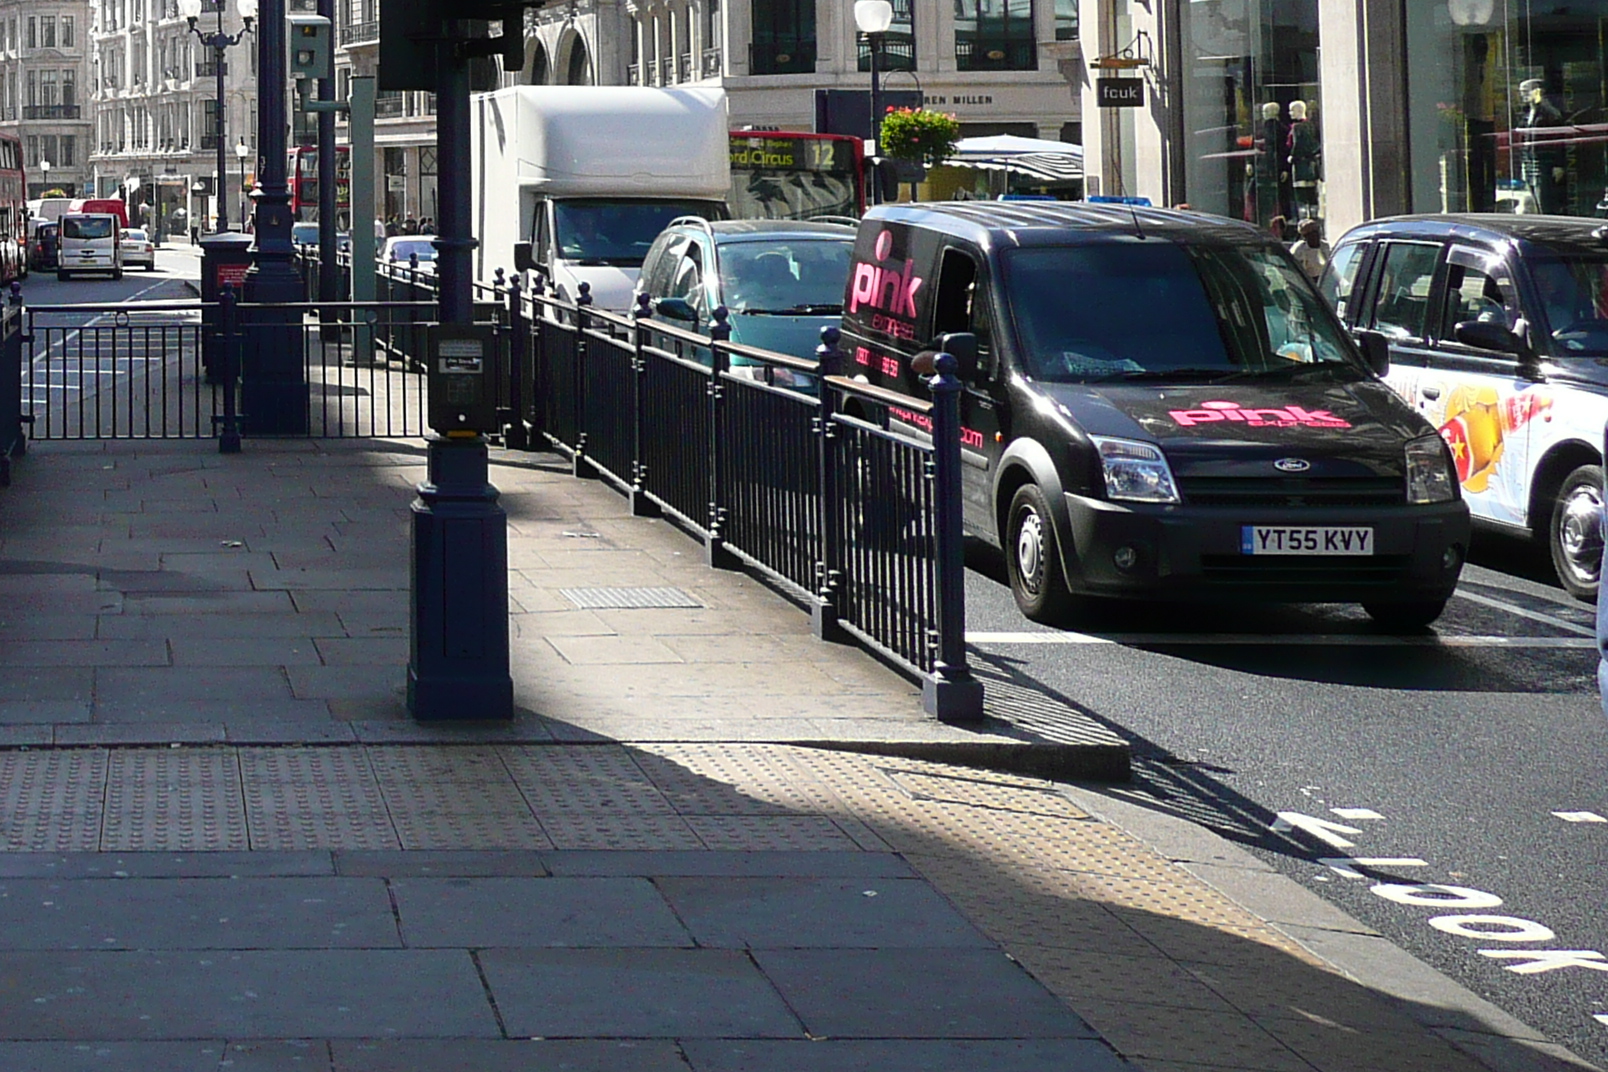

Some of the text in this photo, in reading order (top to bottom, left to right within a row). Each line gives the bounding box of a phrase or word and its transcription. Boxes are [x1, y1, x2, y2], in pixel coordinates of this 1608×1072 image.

[923, 95, 993, 105] REN MILLEN
[1103, 85, 1138, 99] fcuk
[751, 149, 793, 166] Circus
[812, 143, 835, 165] 12
[850, 230, 922, 319] pink
[1168, 400, 1346, 427] pink
[1247, 419, 1352, 428] express
[1257, 529, 1369, 550] YT55 KVY
[1316, 857, 1608, 975] LOOK
